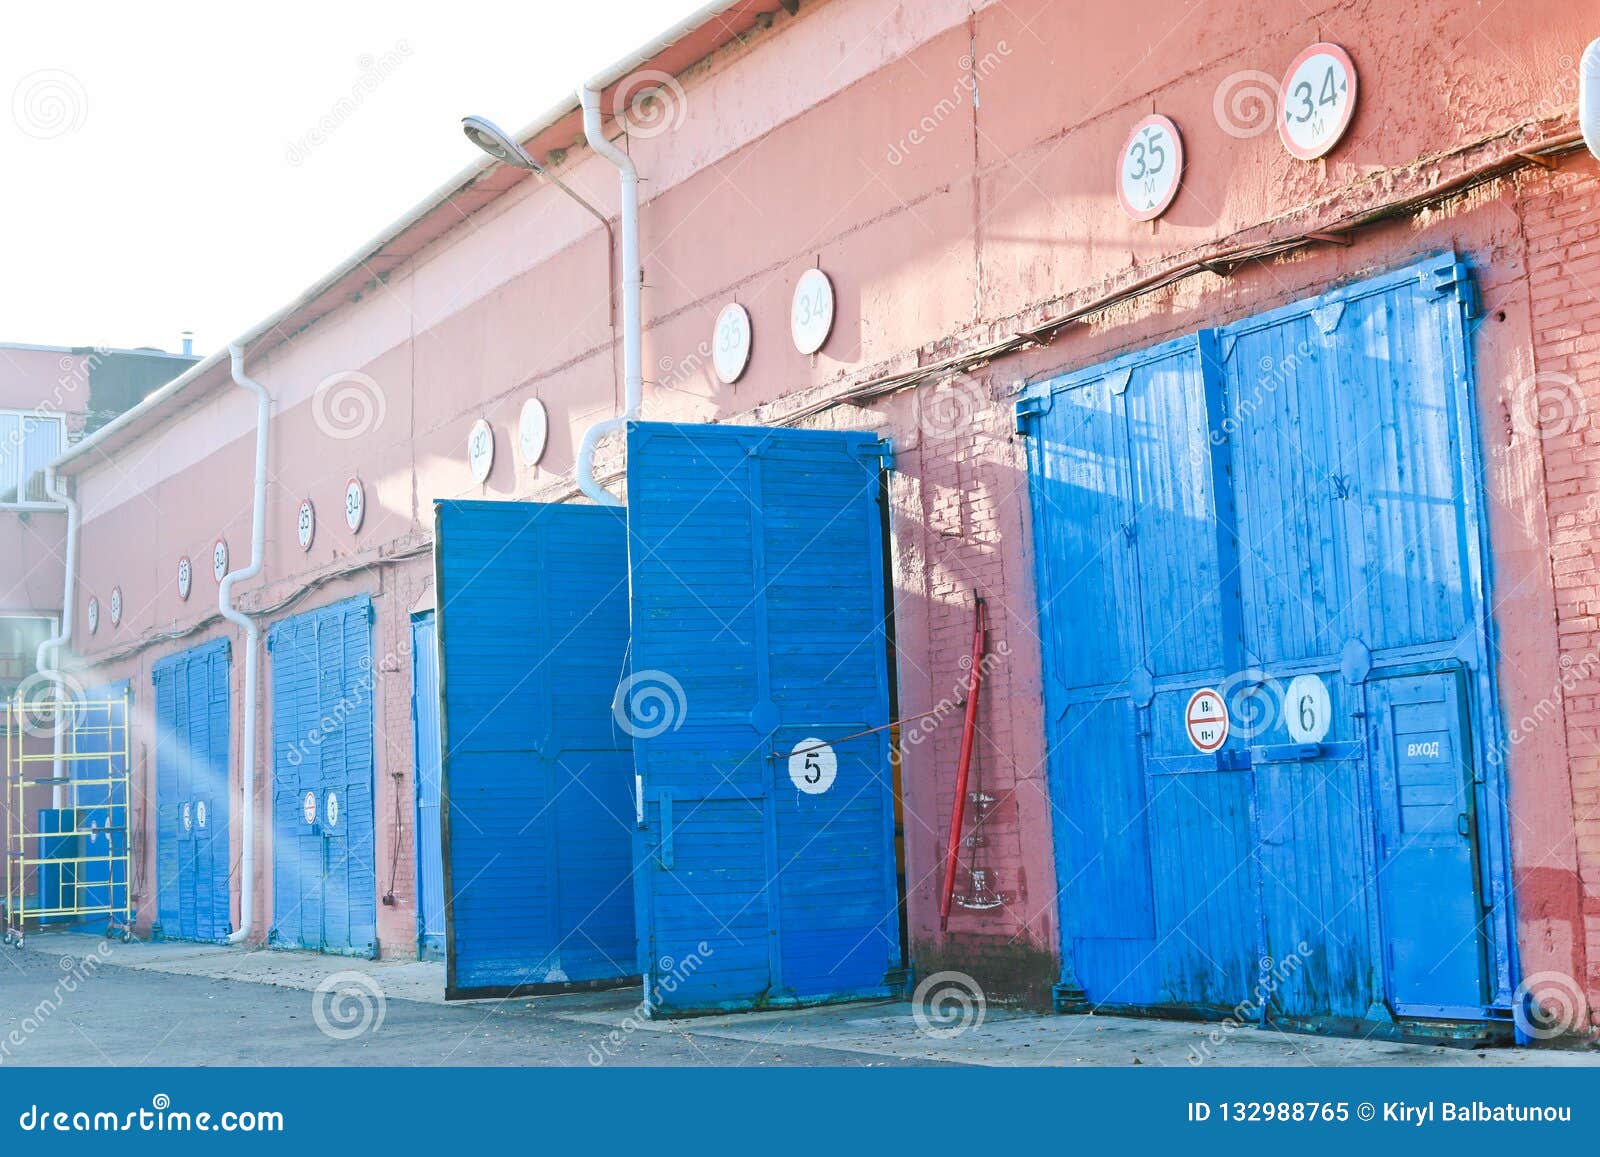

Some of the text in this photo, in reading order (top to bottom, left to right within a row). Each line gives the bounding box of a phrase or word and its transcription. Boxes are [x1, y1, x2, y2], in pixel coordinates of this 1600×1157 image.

[1299, 694, 1316, 733] 6
[1407, 741, 1440, 758] ВХОД
[804, 751, 821, 784] 5
